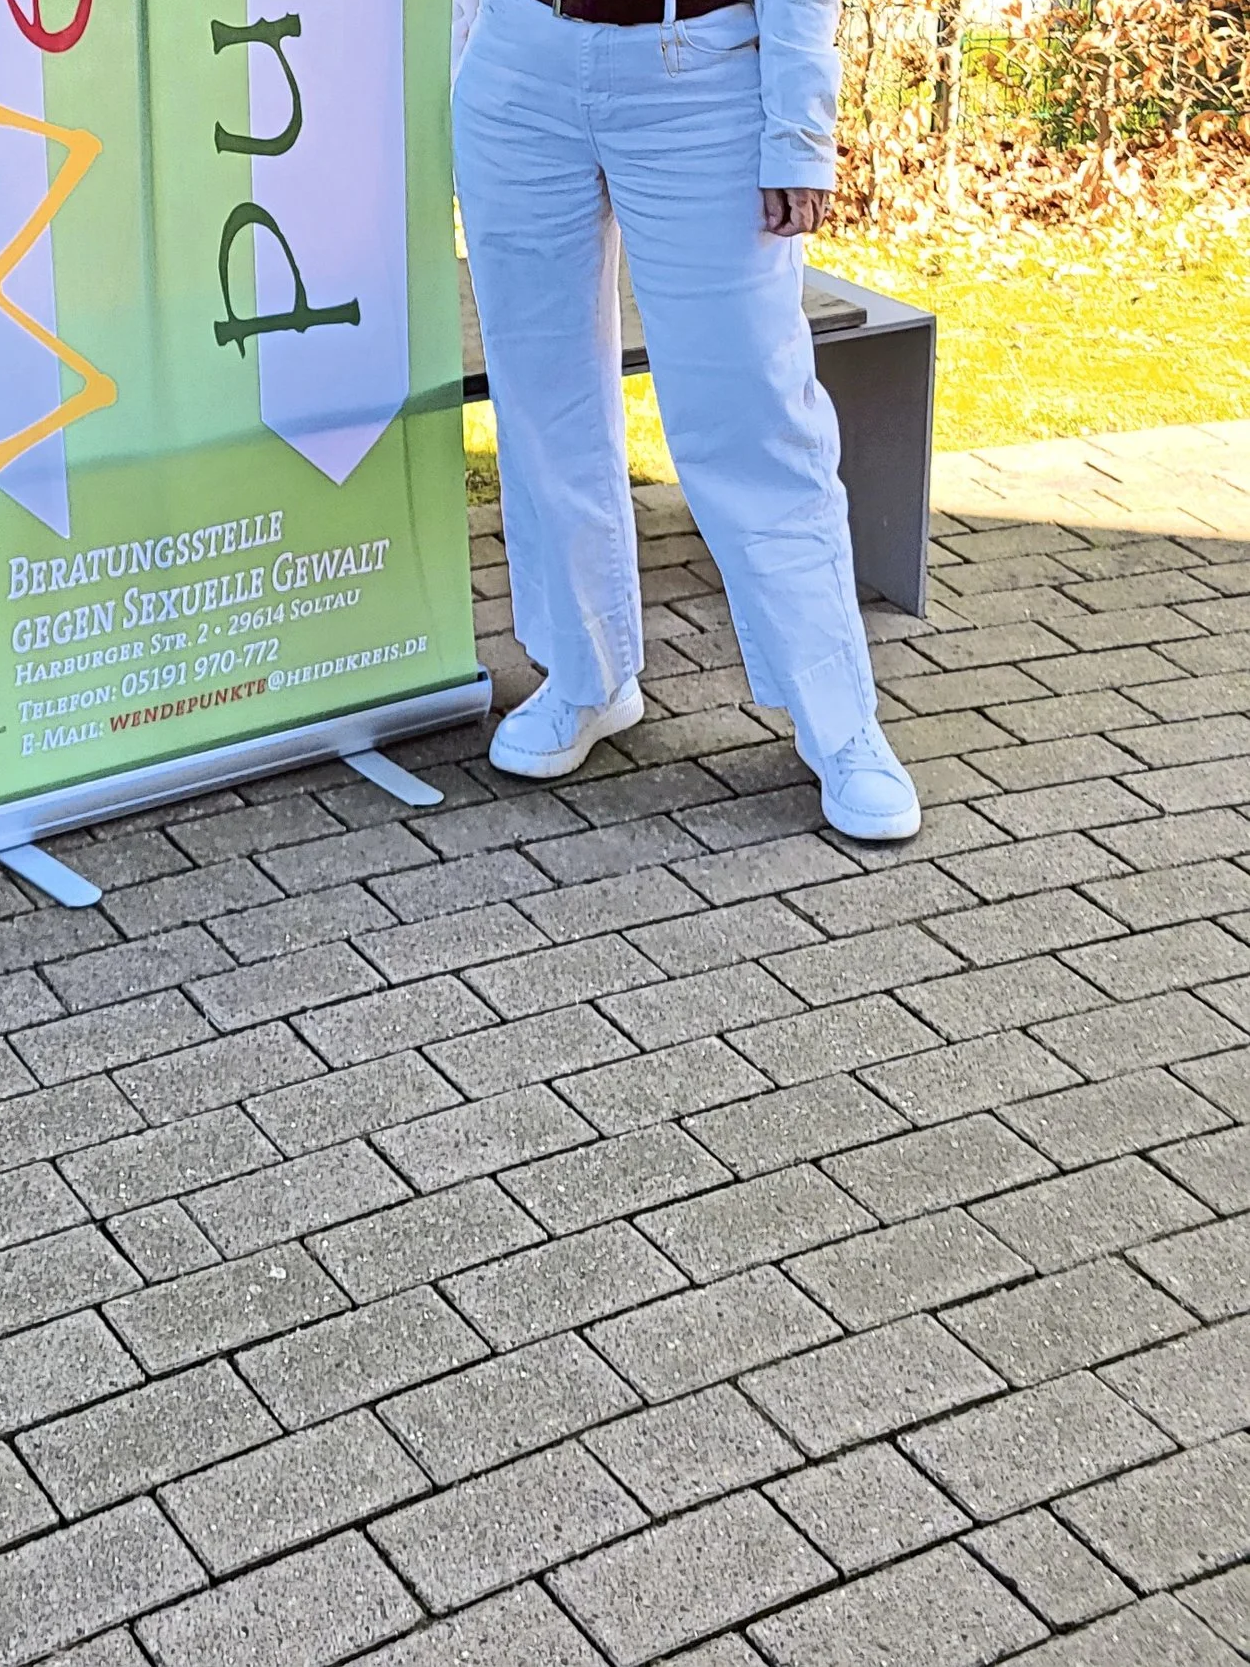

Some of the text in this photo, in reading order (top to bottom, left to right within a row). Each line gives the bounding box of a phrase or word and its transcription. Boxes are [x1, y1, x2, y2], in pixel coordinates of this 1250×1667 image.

[196, 622, 209, 645] 2
[227, 602, 285, 636] 29614
[121, 661, 188, 698] 05191
[193, 637, 280, 682] 970-772
